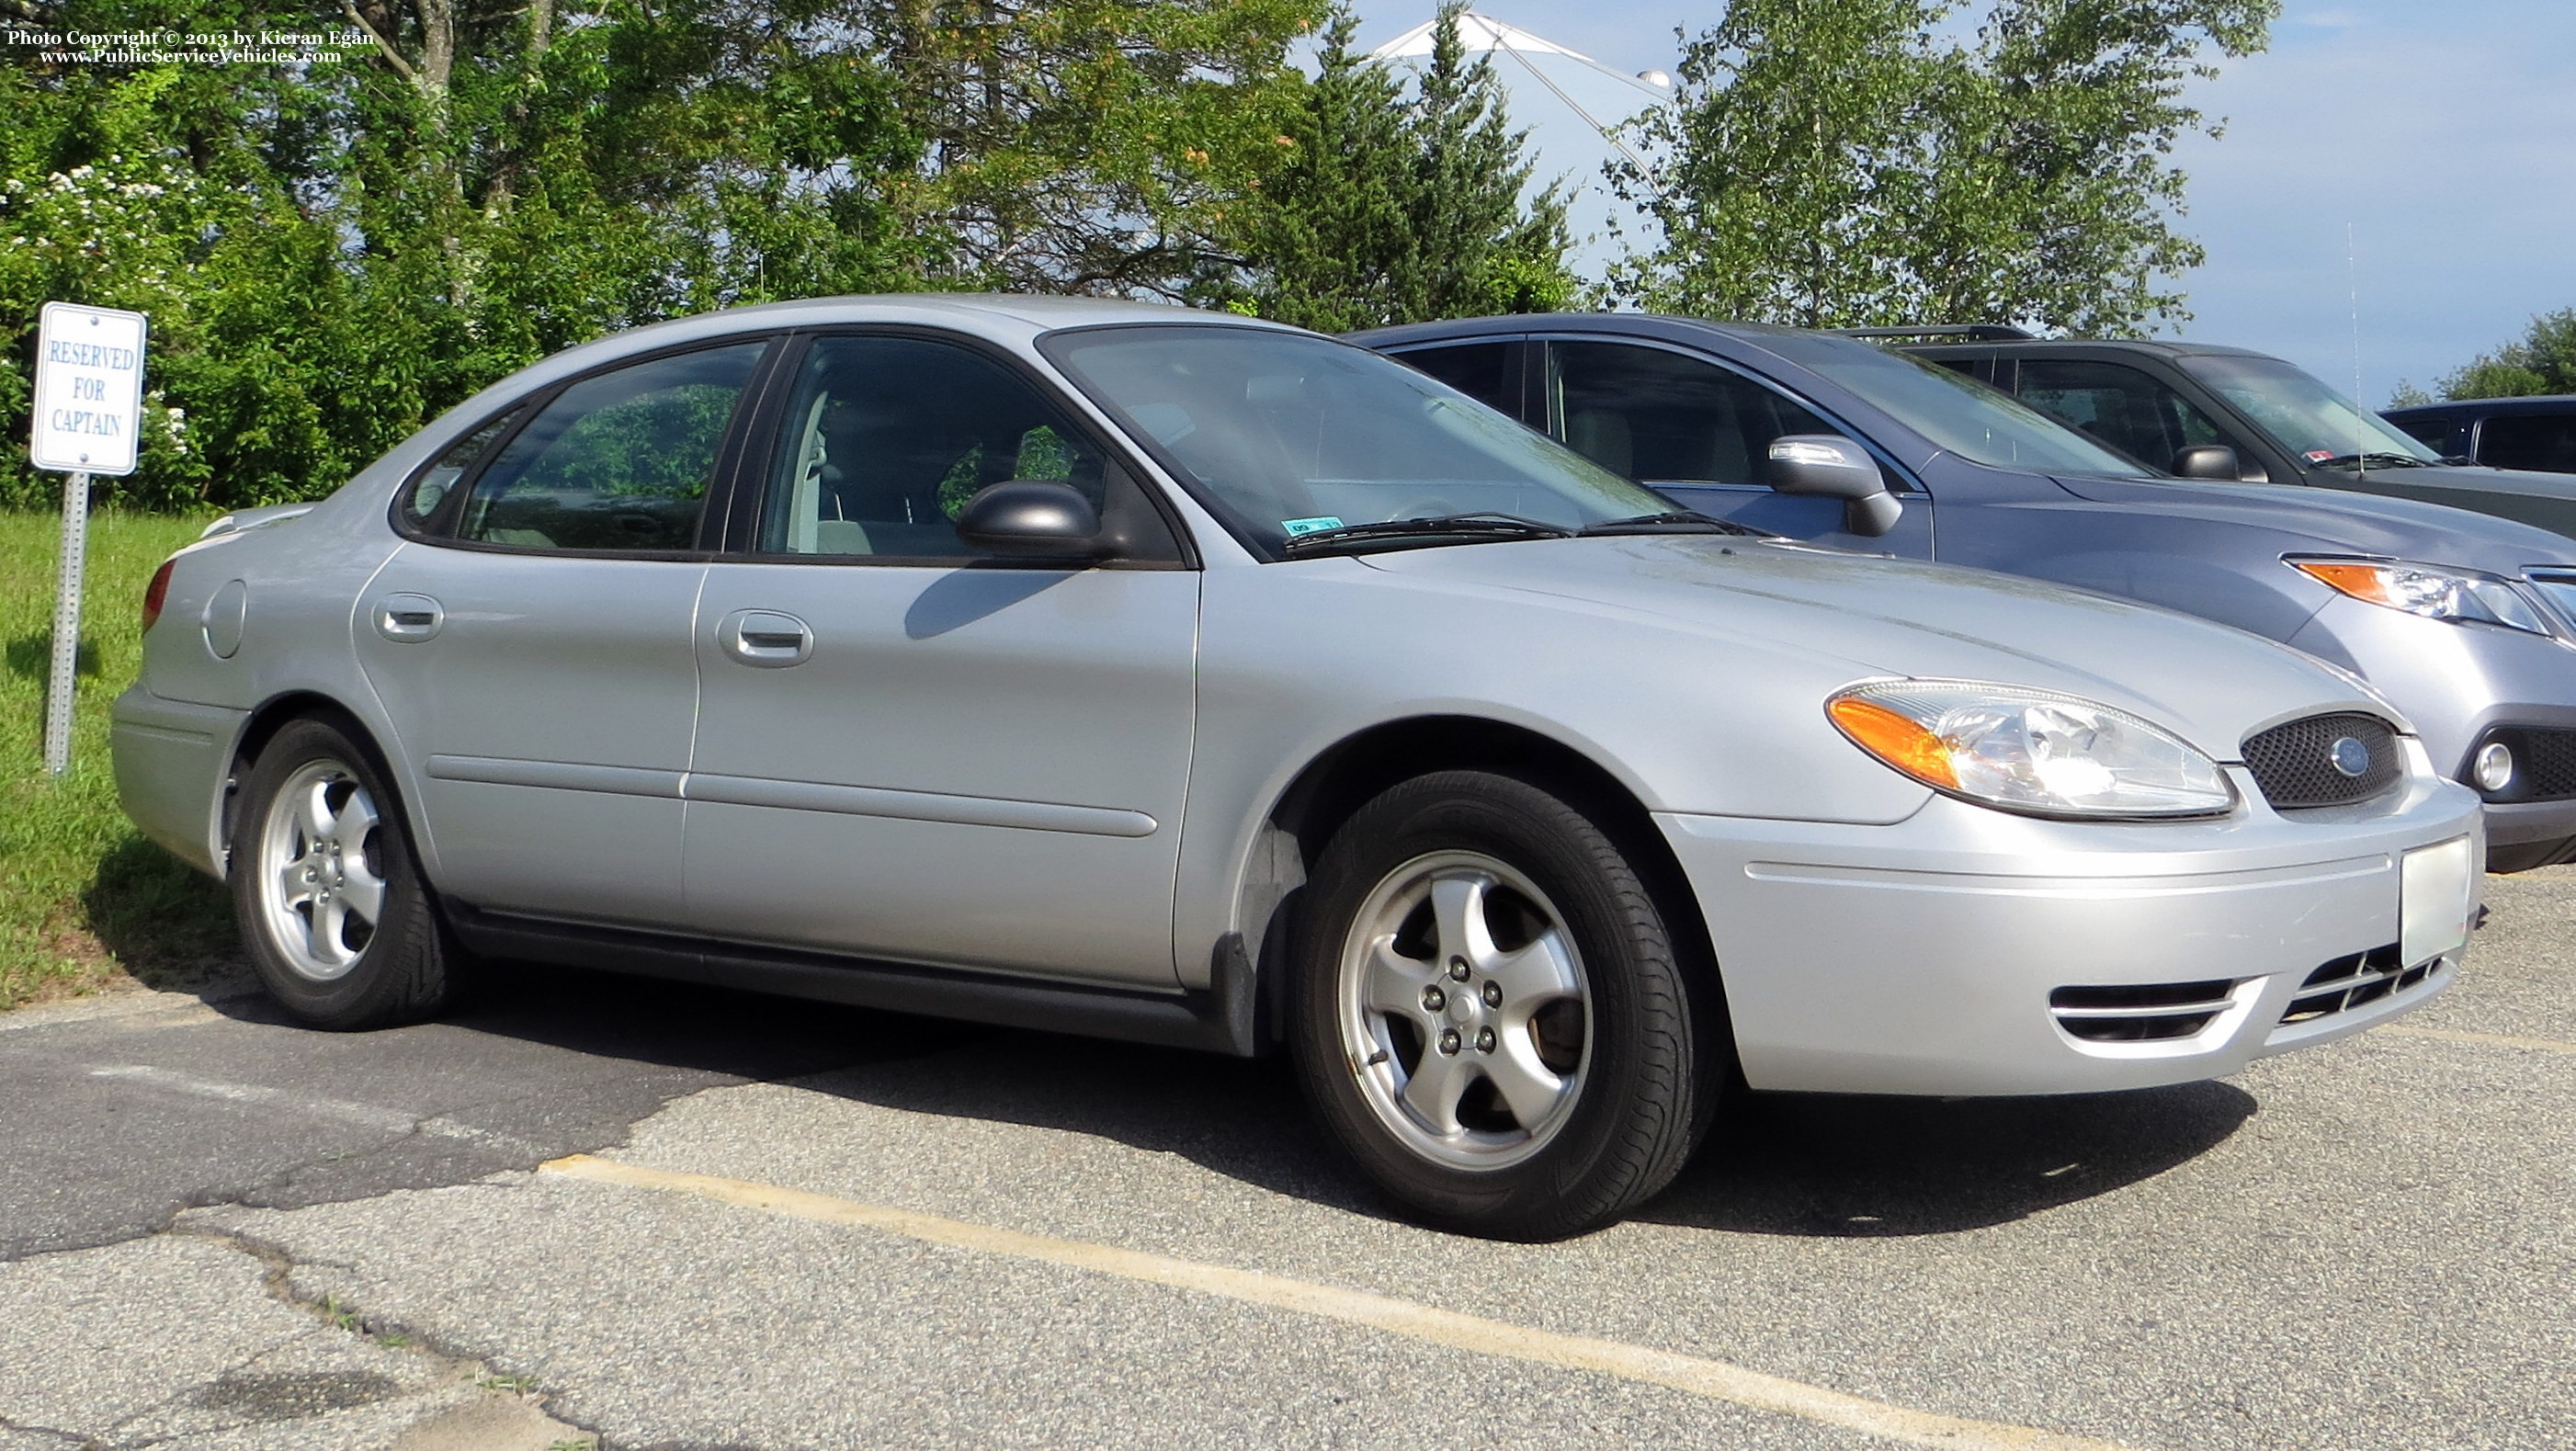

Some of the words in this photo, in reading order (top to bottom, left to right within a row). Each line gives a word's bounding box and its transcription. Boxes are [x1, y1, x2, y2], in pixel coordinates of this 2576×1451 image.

[50, 340, 134, 370] RESERVED
[73, 377, 105, 401] FOR
[51, 409, 121, 436] CAPTAIN
